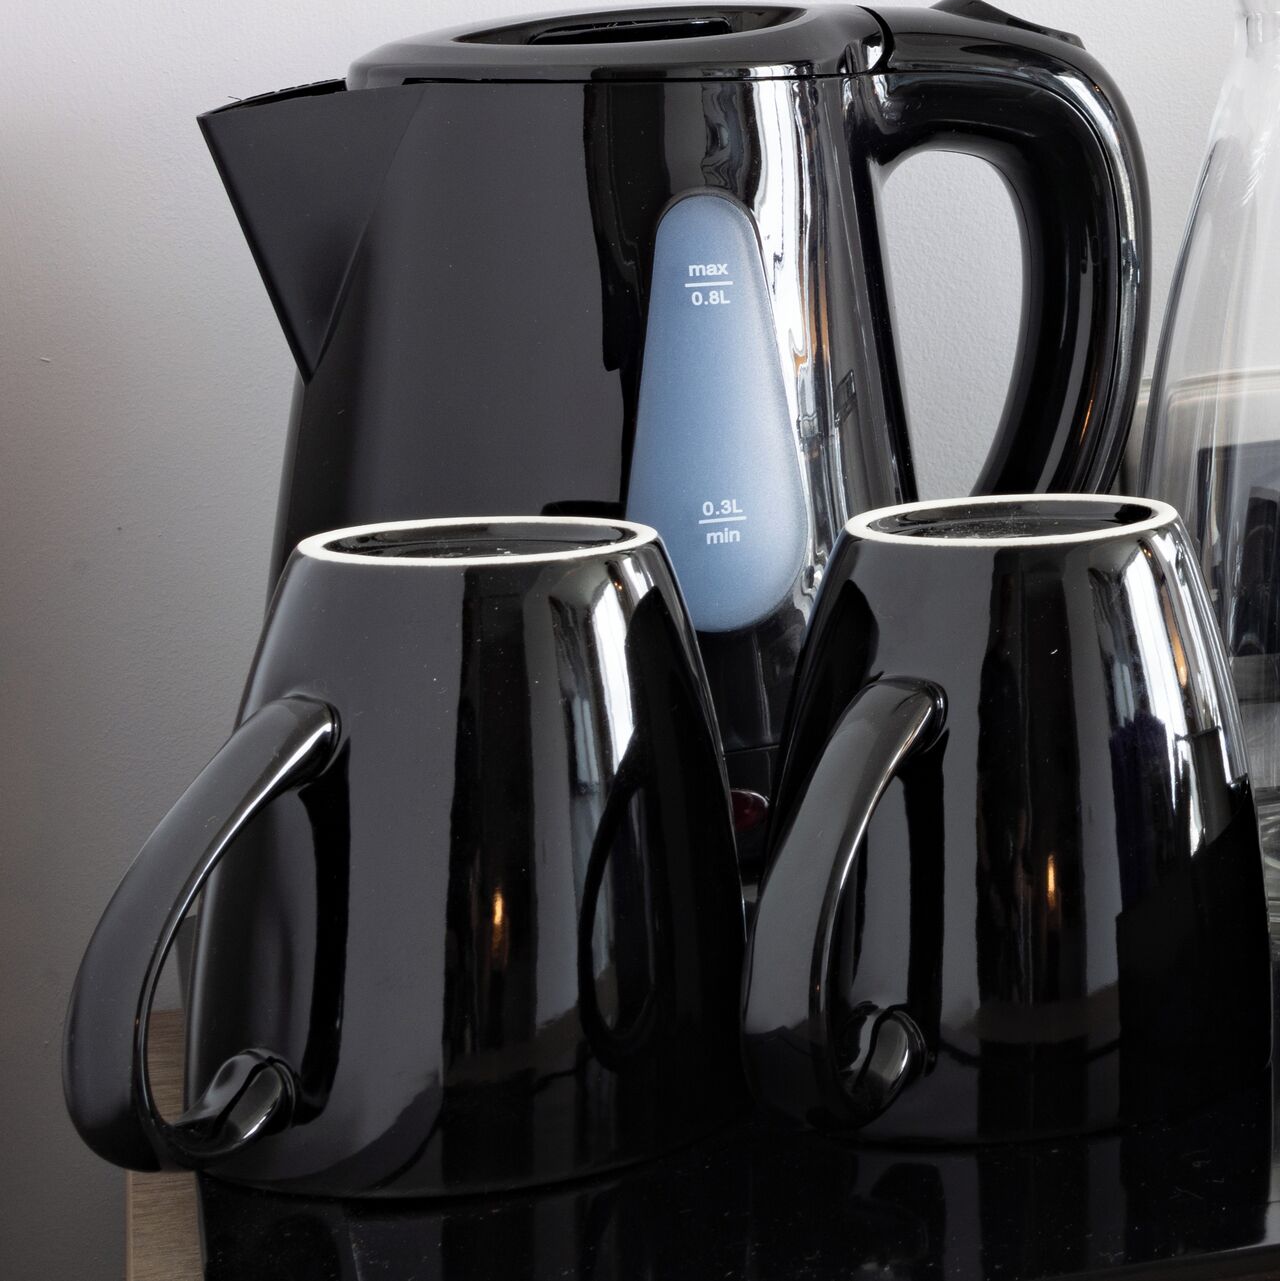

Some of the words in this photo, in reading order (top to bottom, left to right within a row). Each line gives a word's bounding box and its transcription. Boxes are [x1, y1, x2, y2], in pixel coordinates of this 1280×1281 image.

[688, 262, 728, 276] max
[691, 291, 730, 306] 0.8L
[702, 500, 743, 516] 0.3L
[706, 528, 740, 544] min
